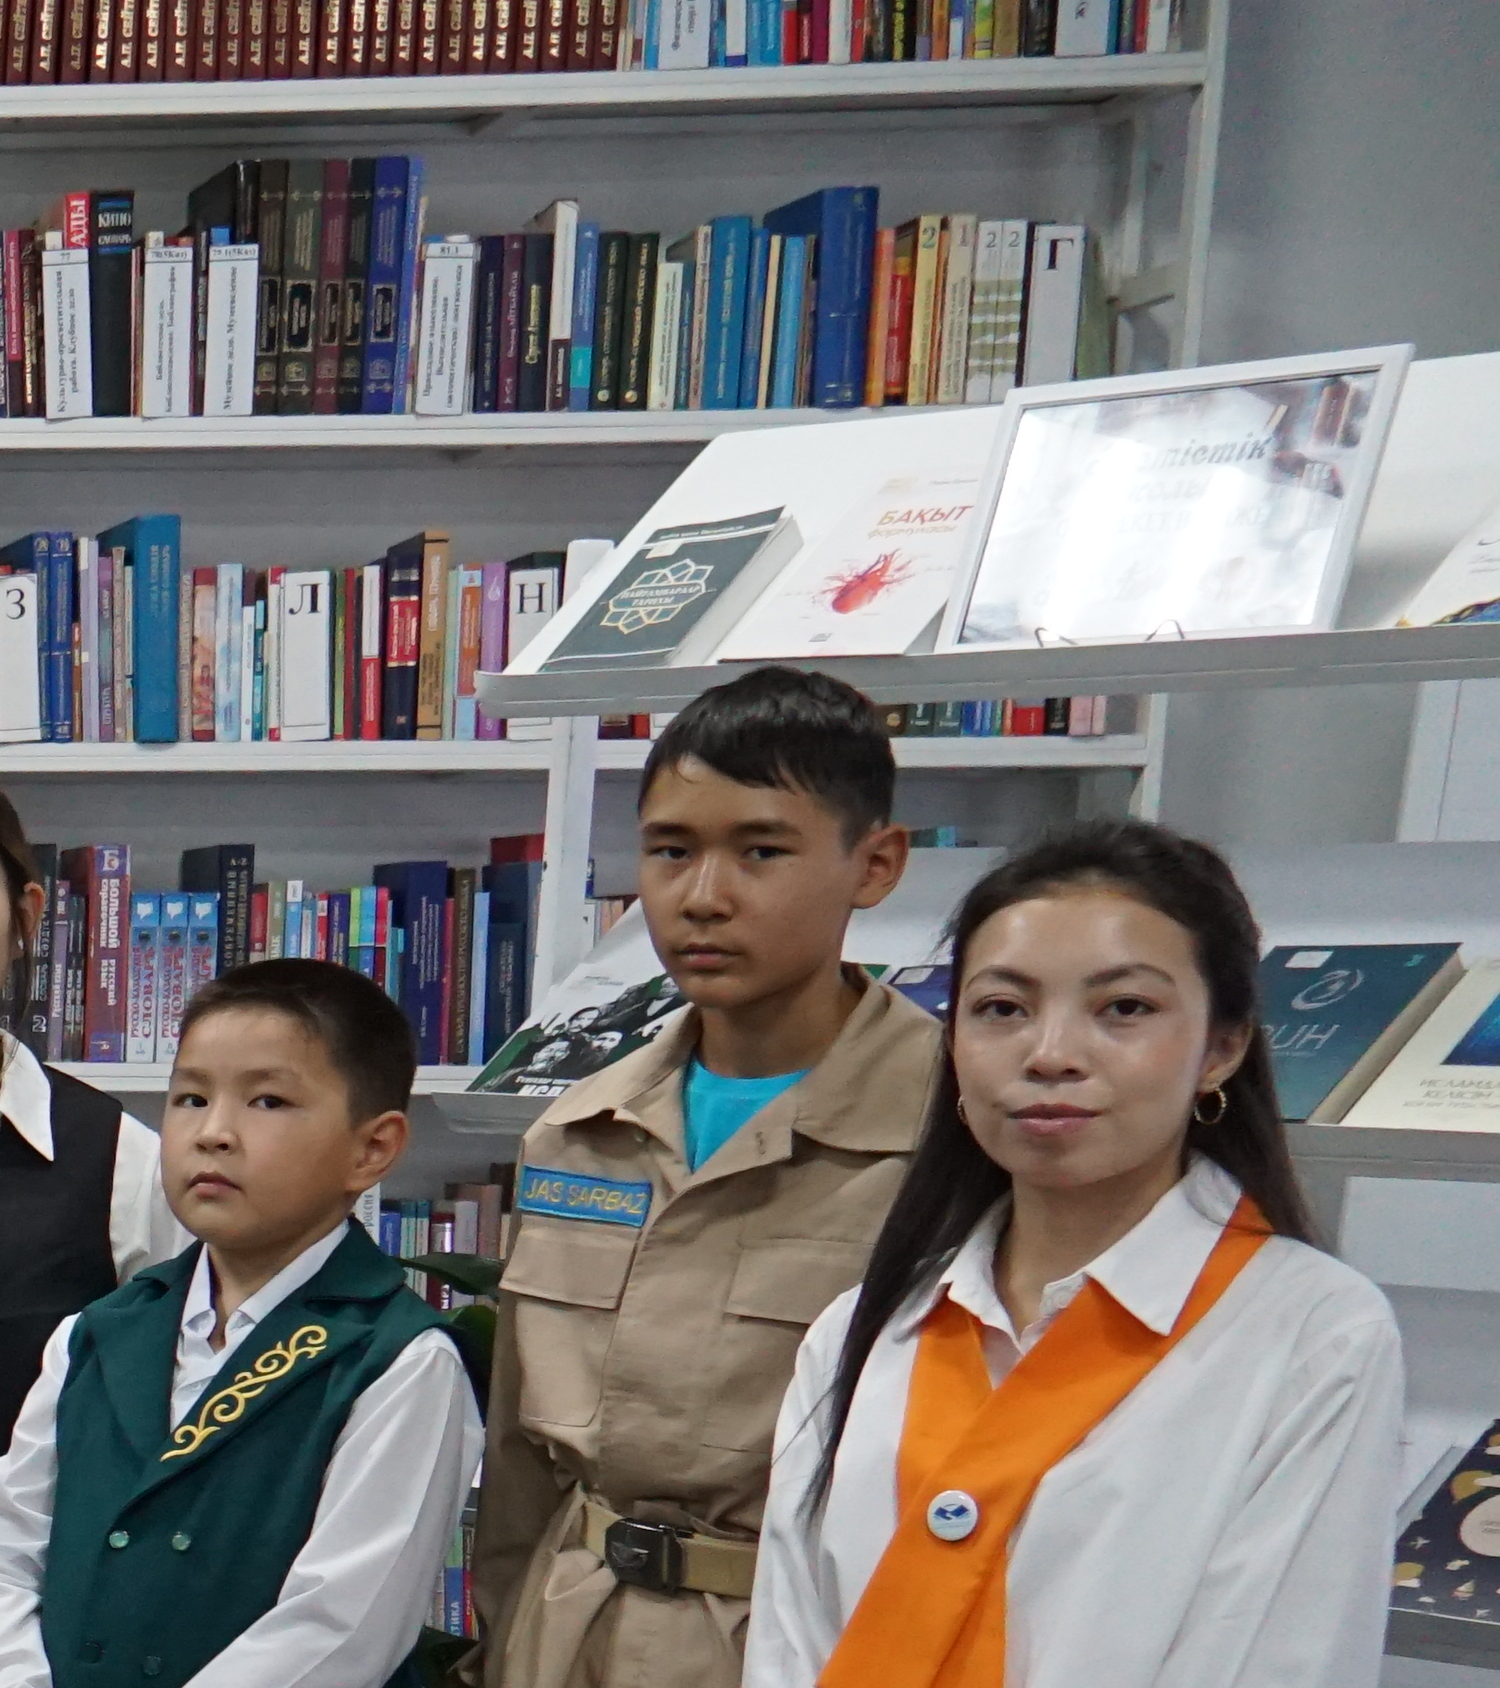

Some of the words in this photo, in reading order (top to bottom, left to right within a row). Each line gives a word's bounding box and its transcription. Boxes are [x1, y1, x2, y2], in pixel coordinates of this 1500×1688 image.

[97, 213, 131, 227] КИНО
[921, 226, 936, 249] 2
[1045, 238, 1074, 271] Г
[876, 505, 974, 526] БАҚЫТ
[5, 588, 25, 620] З
[288, 584, 320, 615] Л
[517, 583, 545, 614] Н
[109, 879, 120, 948] БОЛЬШОЙ
[107, 959, 117, 1005] РУССКИЙ
[142, 947, 154, 1038] СЛОВАРЬ
[526, 1178, 563, 1203] JAS
[567, 1184, 647, 1214] SARBAZ
